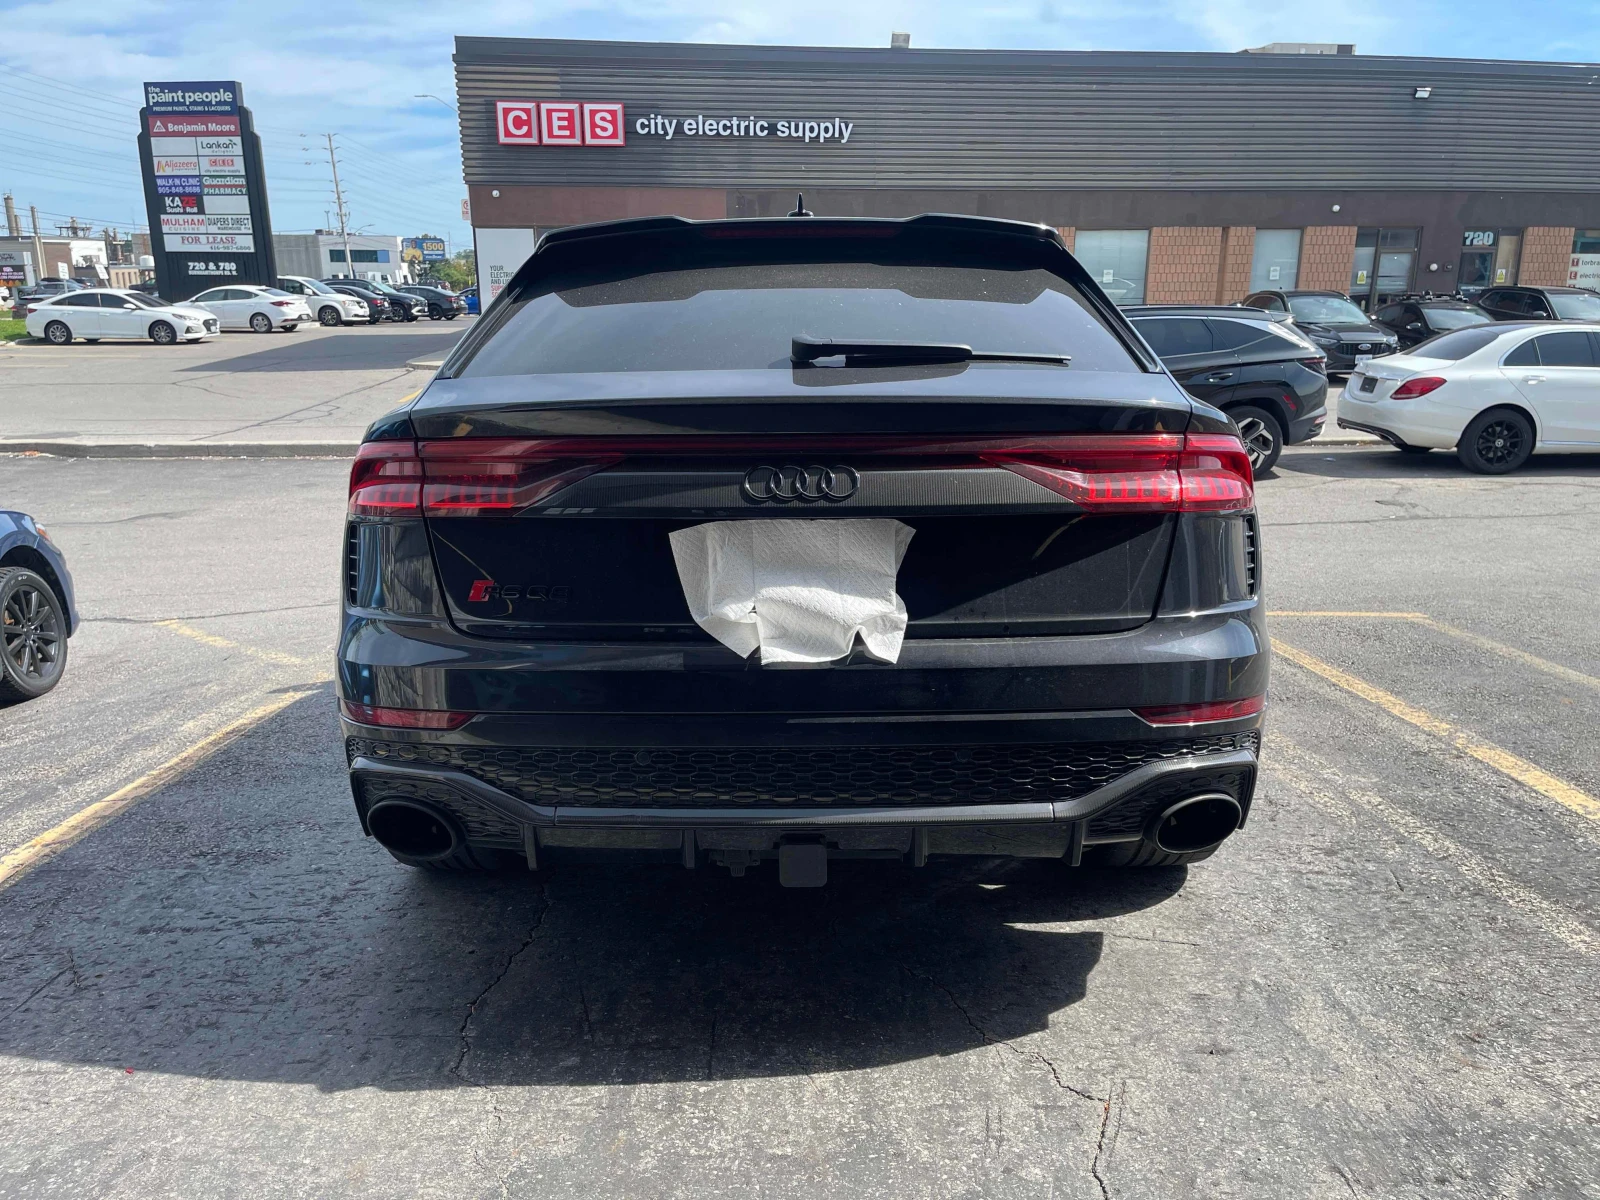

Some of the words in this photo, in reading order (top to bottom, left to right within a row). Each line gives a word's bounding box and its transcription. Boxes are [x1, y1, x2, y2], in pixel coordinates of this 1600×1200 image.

[149, 89, 185, 106] paint
[185, 88, 233, 105] people
[167, 123, 207, 134] Benjamin
[208, 123, 236, 132] Moore
[503, 107, 619, 140] CES
[635, 114, 678, 140] city
[683, 114, 768, 137] electric
[776, 117, 854, 143] supply
[201, 140, 234, 150] Lankan
[164, 159, 198, 172] Aljazeera
[156, 178, 181, 186] WALK-IN
[181, 177, 201, 186] CLINIC
[202, 176, 246, 185] Guardian
[203, 187, 247, 195] PHARMACY
[165, 196, 198, 207] KAZE
[161, 218, 205, 226] MULHAM
[207, 217, 230, 226] DIAPERS
[231, 217, 250, 226] DIRECT
[181, 236, 202, 245] FOR
[1464, 231, 1494, 246] 720
[422, 242, 444, 251] 1500
[188, 262, 206, 271] 720
[208, 262, 217, 271] &
[218, 262, 237, 271] 780
